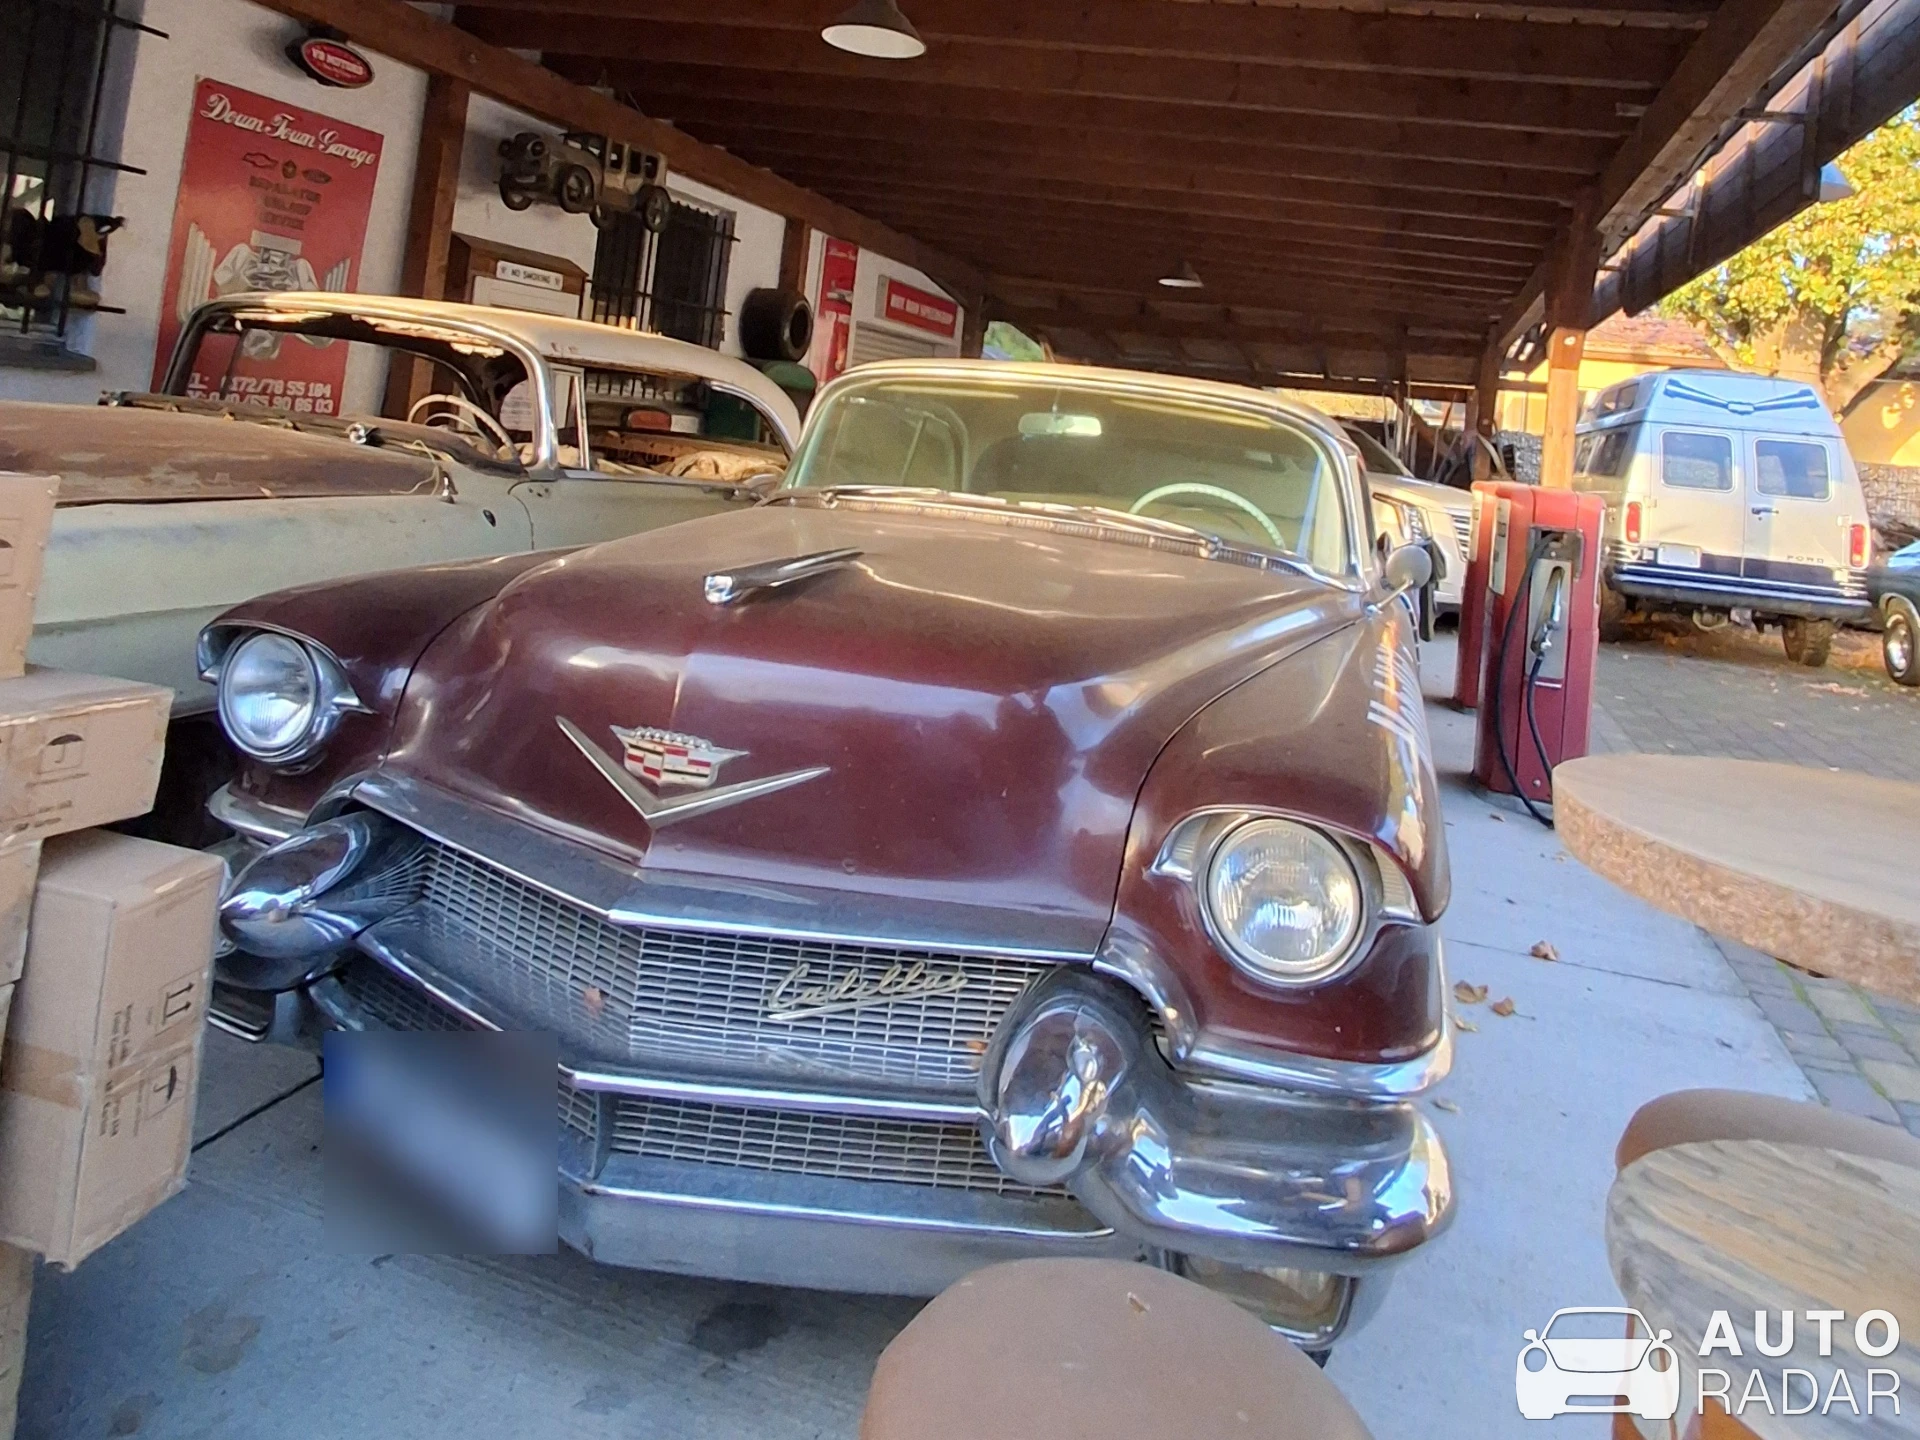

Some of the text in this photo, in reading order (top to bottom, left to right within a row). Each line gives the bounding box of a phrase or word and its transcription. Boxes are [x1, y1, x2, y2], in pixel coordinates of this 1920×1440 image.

[199, 93, 377, 169] Down Town Garage
[510, 268, 551, 285] NO SMOKING
[315, 398, 334, 414] 03
[1786, 554, 1825, 565] FORD
[768, 960, 969, 1017] Cadillac
